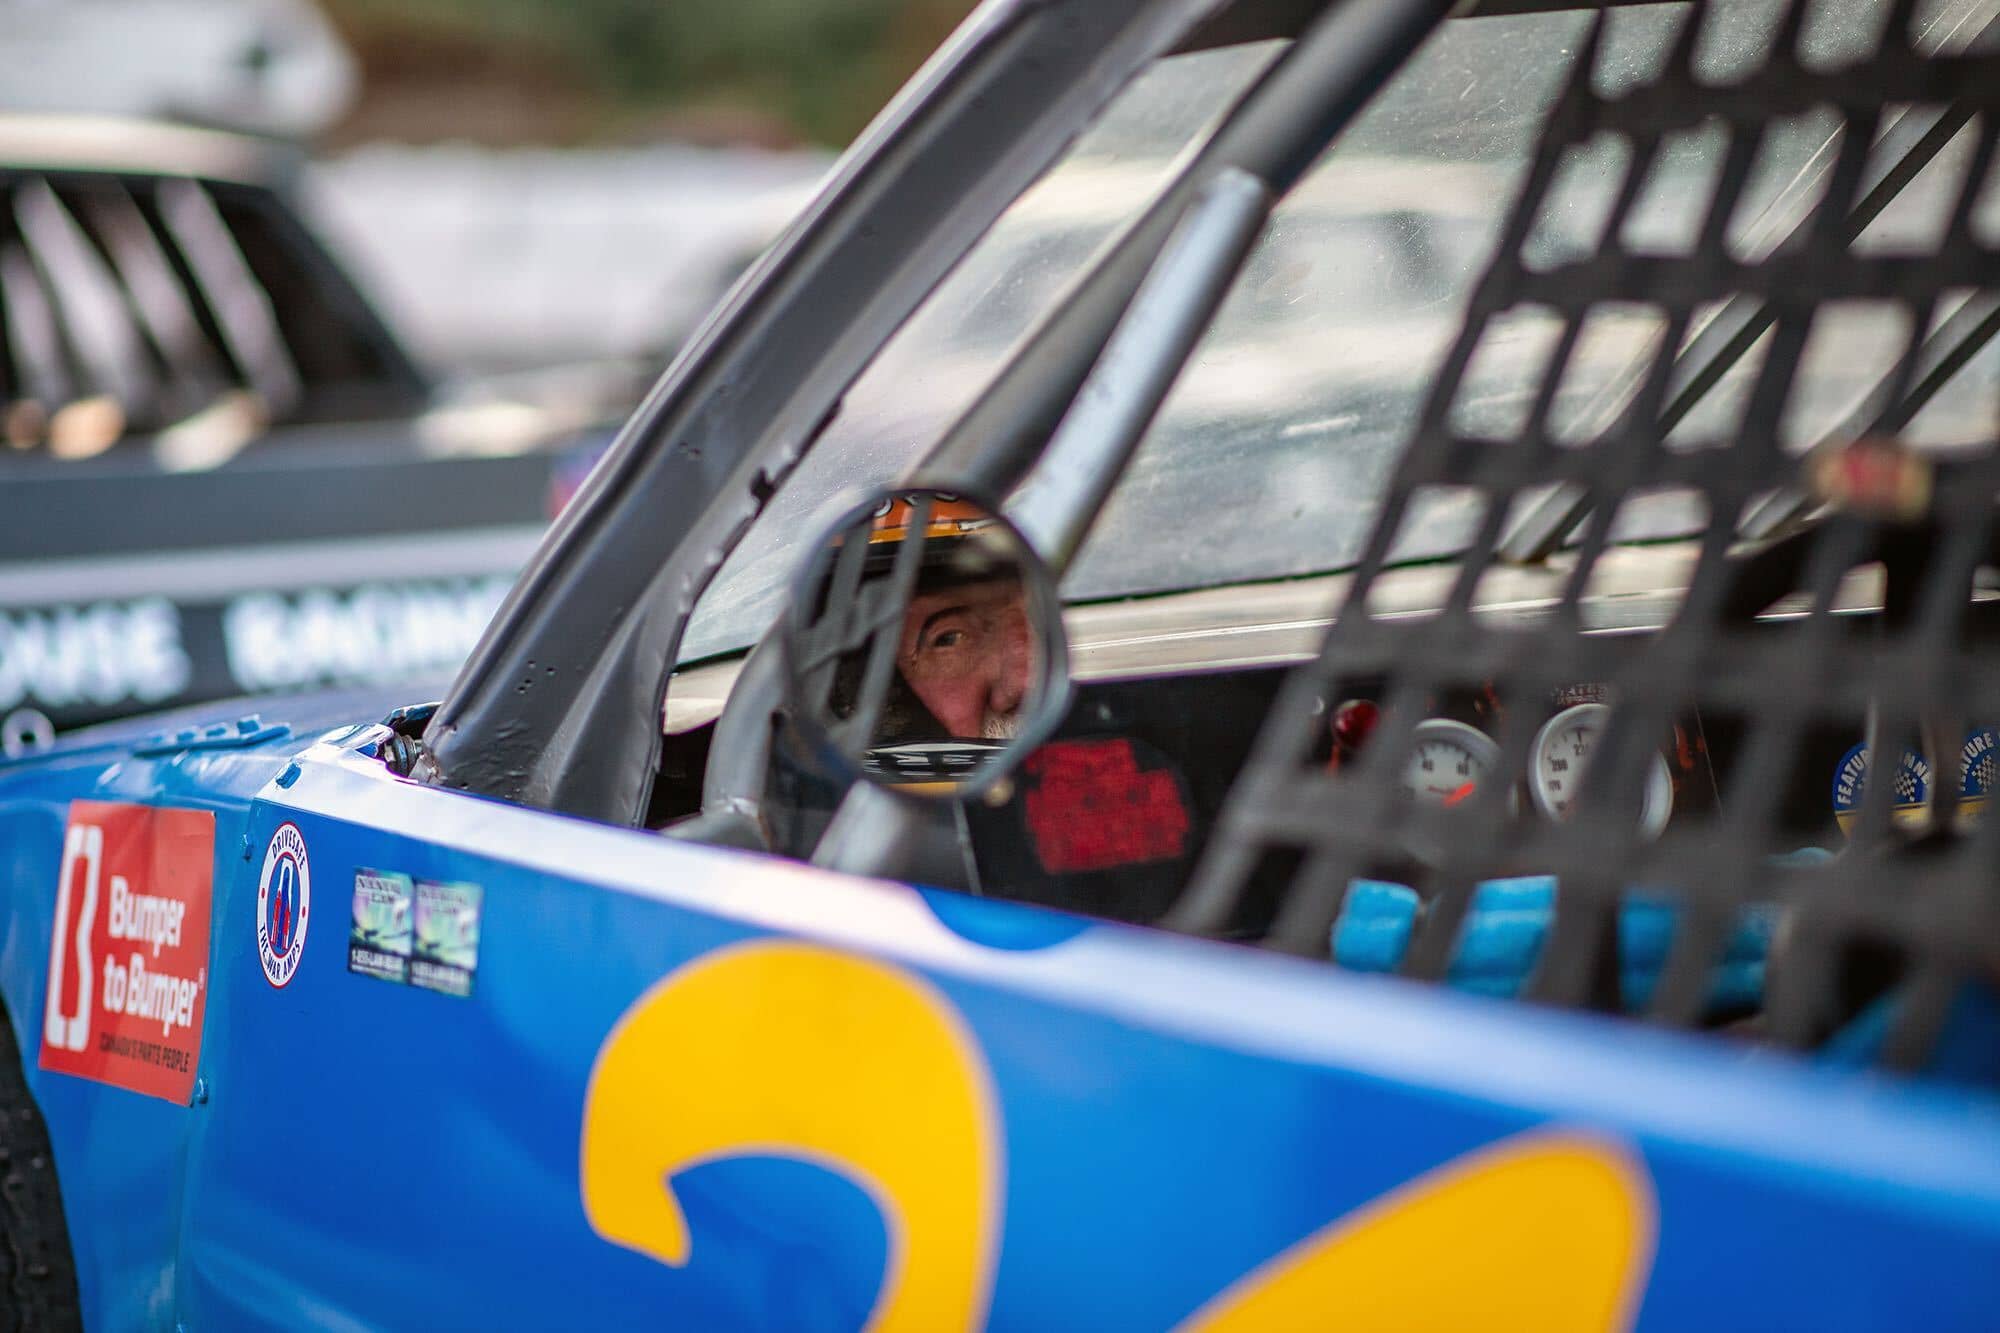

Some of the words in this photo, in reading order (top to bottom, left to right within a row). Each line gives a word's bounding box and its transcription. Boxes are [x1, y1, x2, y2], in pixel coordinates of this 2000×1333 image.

[224, 580, 516, 692] RACIN
[1837, 748, 1870, 805] FEATU
[109, 875, 185, 958] Bumper
[259, 923, 269, 957] THE
[267, 955, 281, 980] WAR
[282, 939, 301, 979] AMPS
[103, 953, 128, 1013] to
[163, 1046, 190, 1074] PEOPLE
